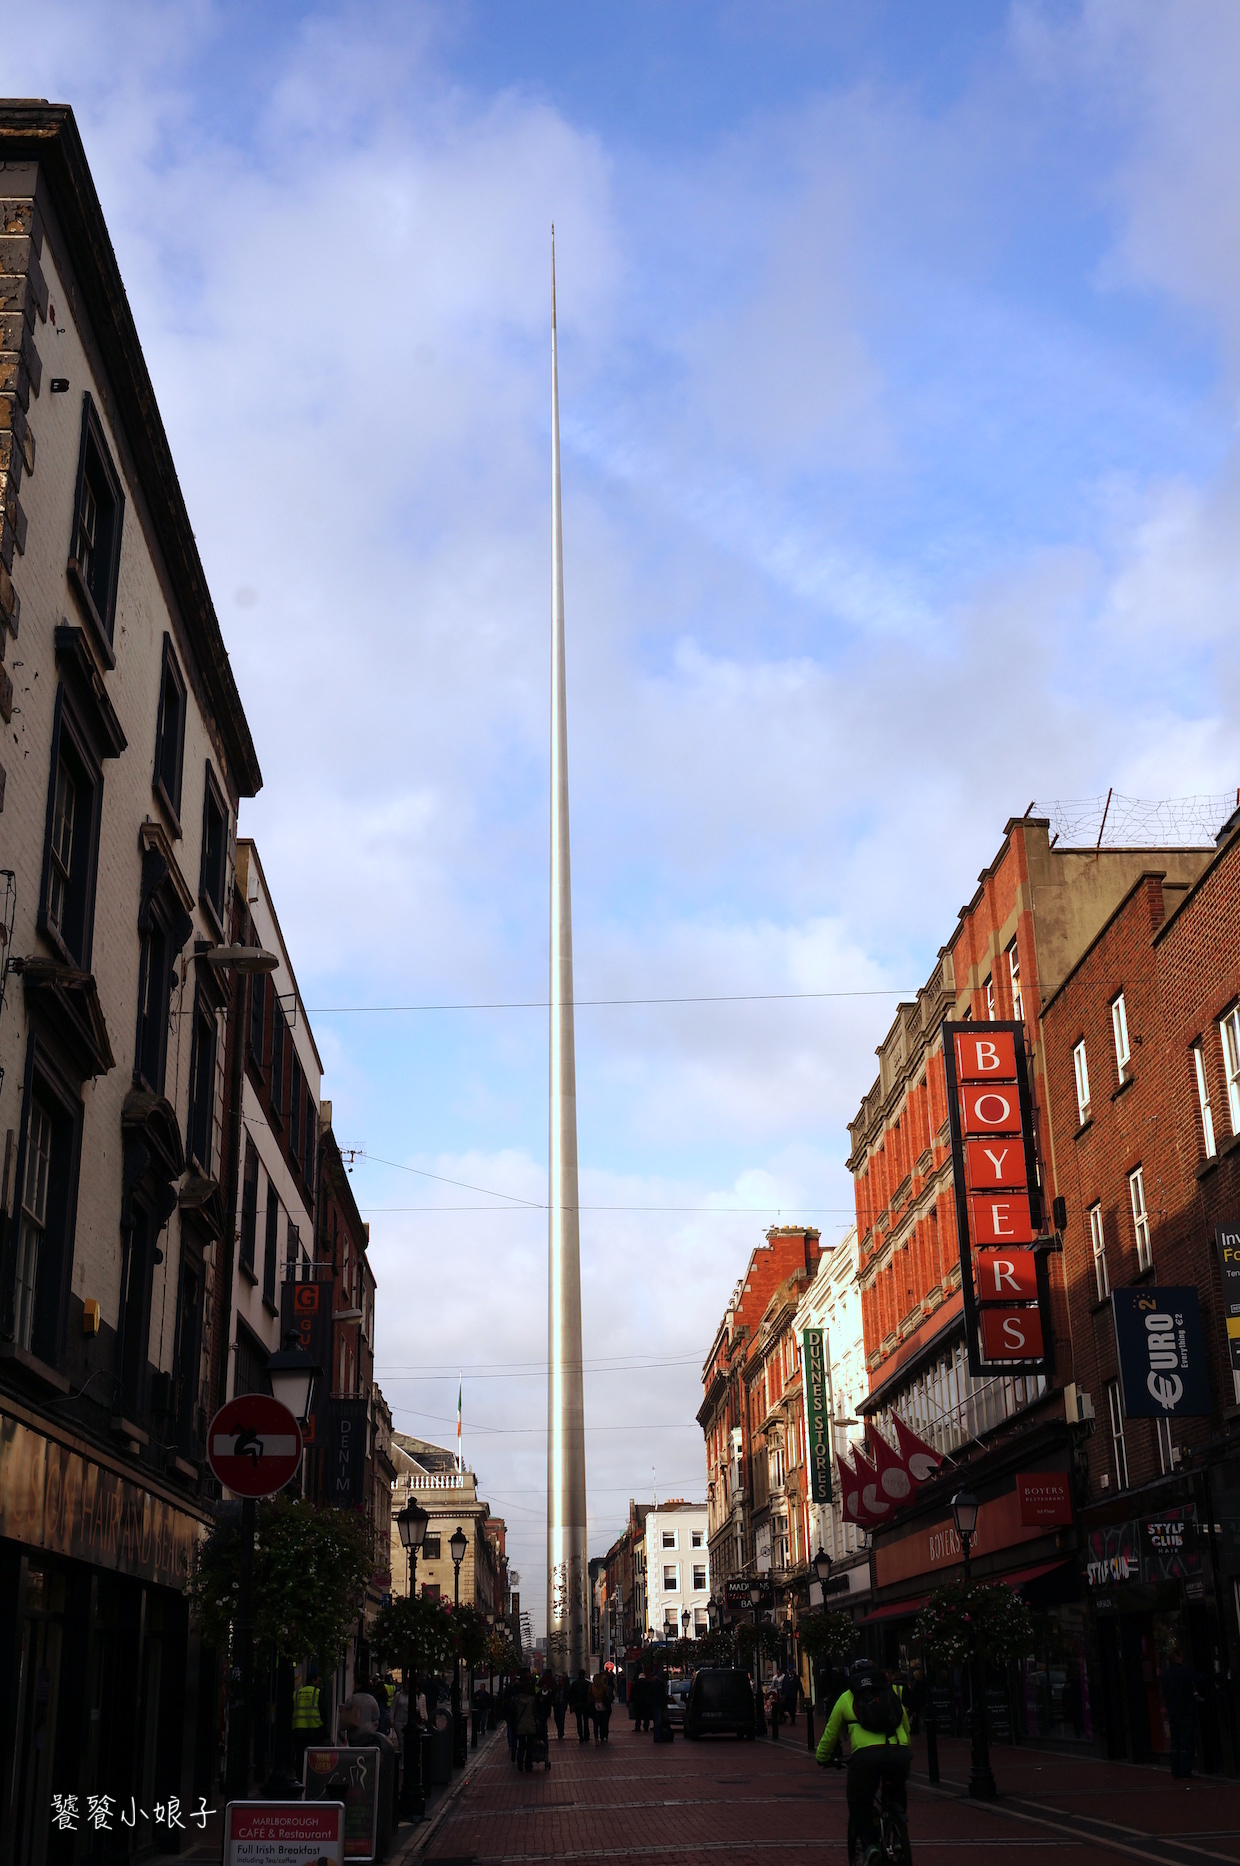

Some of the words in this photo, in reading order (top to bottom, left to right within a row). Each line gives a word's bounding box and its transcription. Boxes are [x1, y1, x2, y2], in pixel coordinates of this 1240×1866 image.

[974, 1041, 1026, 1350] BOYERS
[1177, 1329, 1189, 1369] Everything
[808, 1332, 823, 1411] DUNNES
[336, 1420, 352, 1491] DENIM
[814, 1416, 827, 1498] STORES
[1024, 1487, 1064, 1495] BOYERS
[80, 1481, 123, 1554] HAIR
[121, 1500, 152, 1566] AND
[929, 1529, 961, 1561] BOYERS
[1151, 1535, 1184, 1547] CLUB
[238, 1826, 265, 1838] CAFÉ
[268, 1829, 276, 1838] &
[278, 1828, 332, 1839] Restaurant
[252, 1817, 319, 1826] MARLBOROUGH
[236, 1856, 264, 1865] including
[265, 1856, 297, 1864] Tea/coffee
[237, 1844, 253, 1854] Full
[256, 1844, 275, 1854] Irish
[278, 1845, 321, 1855] Breakfast
